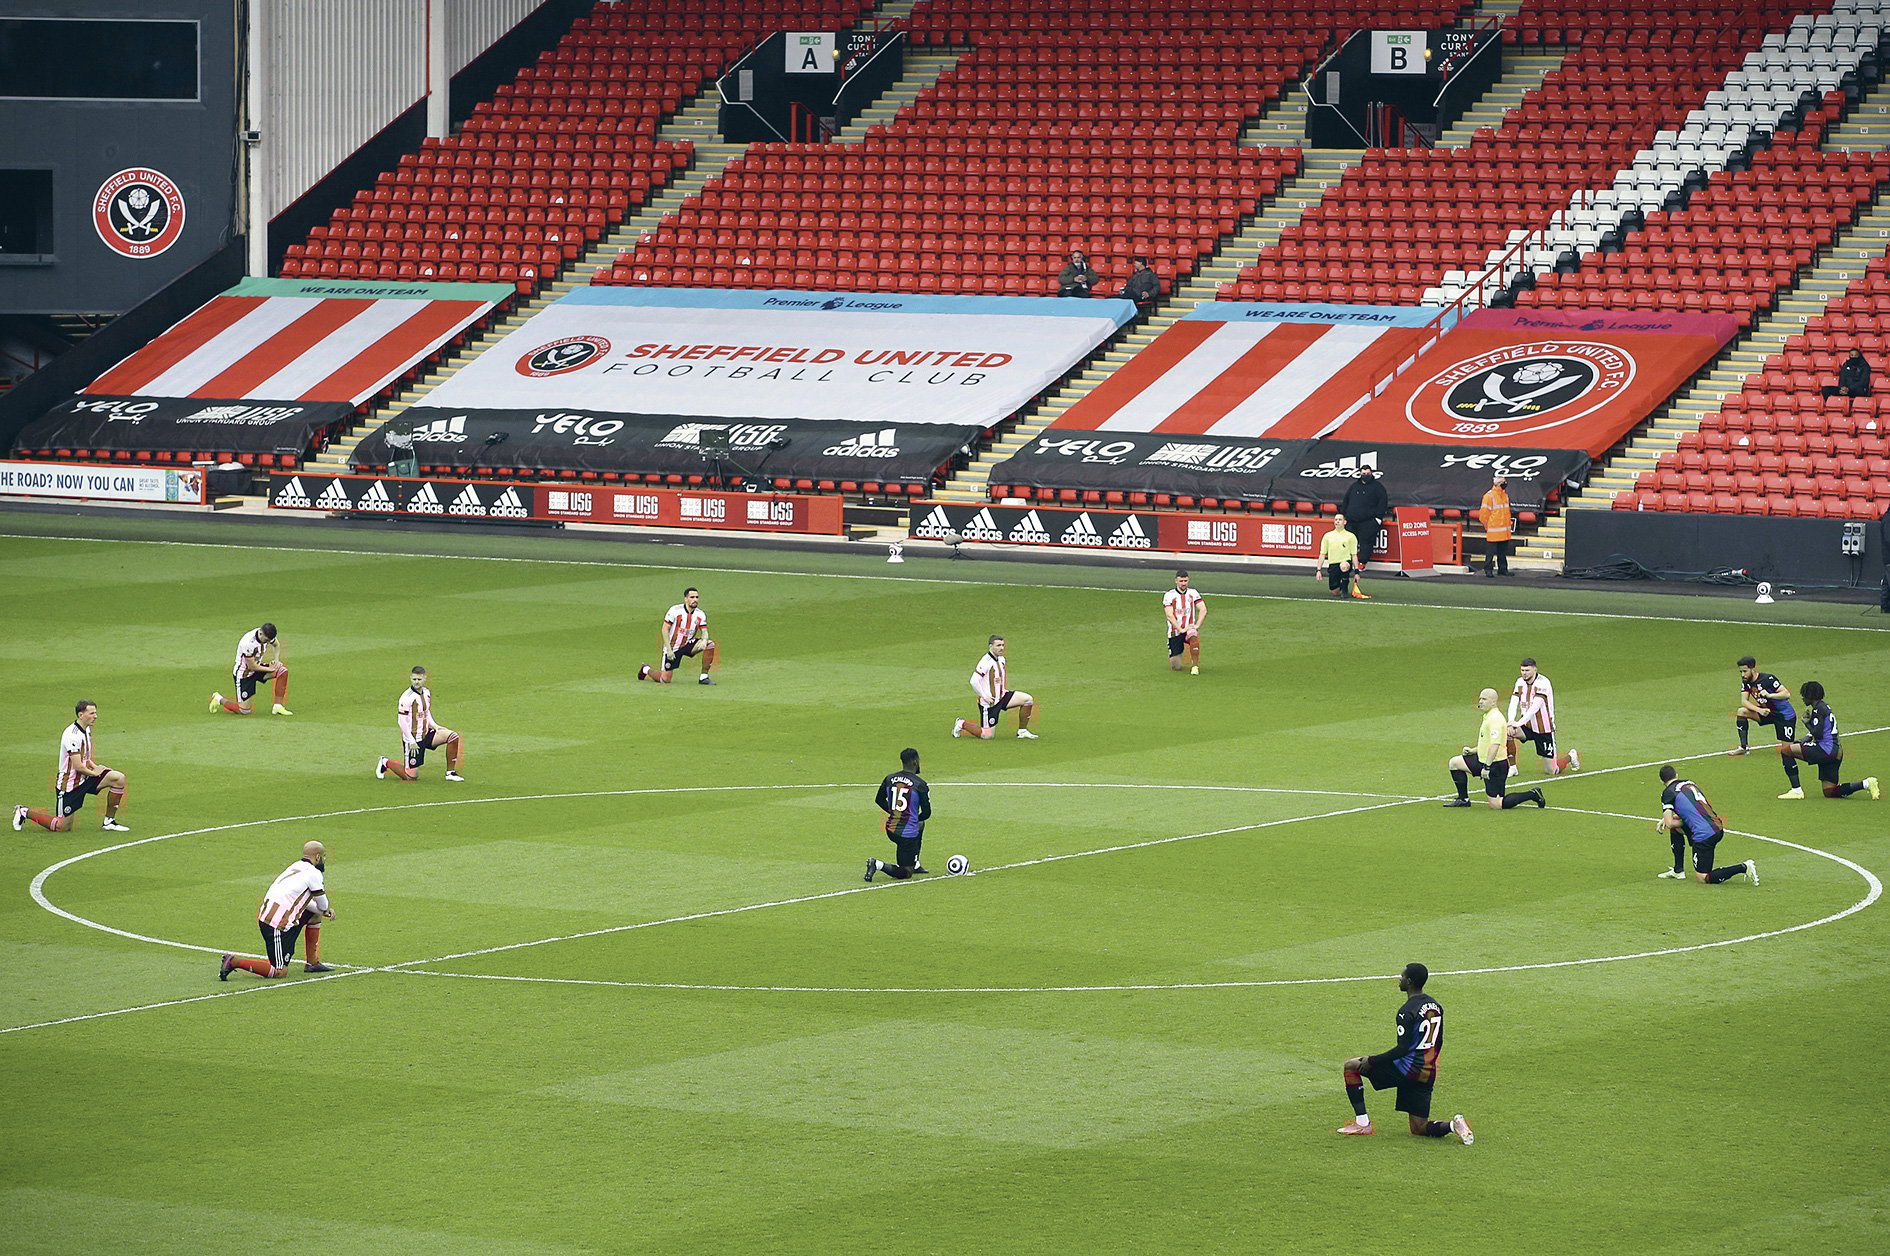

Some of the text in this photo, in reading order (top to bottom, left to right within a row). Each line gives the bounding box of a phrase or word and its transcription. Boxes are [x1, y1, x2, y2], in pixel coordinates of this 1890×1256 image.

[801, 48, 818, 69] A
[1391, 47, 1407, 70] B
[97, 172, 180, 214] SHEFFIELD UNITED F.C.
[129, 245, 151, 254] 1889
[763, 297, 903, 311] Premier League
[1271, 311, 1308, 319] ARE
[1309, 312, 1346, 320] ONE
[1349, 313, 1397, 322] TEAM
[1608, 317, 1672, 331] League
[625, 343, 1013, 368] SHEFFIELD UNITED
[601, 362, 986, 386] FOOTBALL CLUB
[1435, 344, 1625, 392] SHEFFIELD UNITED F.C.
[70, 401, 159, 414] YELO
[234, 406, 304, 421] USG
[531, 413, 624, 437] YELO
[1451, 422, 1500, 434] 1889
[413, 430, 468, 443] didas
[822, 443, 900, 458] adidas
[1034, 438, 1136, 456] YELO
[1206, 446, 1282, 469] USG
[1440, 453, 1547, 469] YELO
[17, 472, 53, 488] ROAD?
[56, 473, 83, 489] NOW
[88, 475, 110, 491] YOU
[113, 477, 134, 492] CAN
[274, 496, 311, 508] adidas
[315, 496, 352, 510] adidas
[357, 499, 395, 512] adidas
[407, 501, 444, 514] adidas
[570, 492, 592, 511] USG
[636, 495, 658, 514] USG
[703, 498, 725, 518] USG
[448, 503, 486, 516] adidas
[489, 505, 528, 518] adidas
[915, 525, 956, 538] adidas
[1212, 521, 1237, 541] USG
[1414, 521, 1427, 529] ZONE
[961, 527, 1003, 541] adidas
[1008, 529, 1051, 544] adidas
[1060, 532, 1102, 546] adidas
[1108, 534, 1150, 548] adidas
[1287, 524, 1312, 545] USG
[1783, 726, 1793, 739] 10
[1543, 742, 1553, 753] 14
[890, 786, 910, 812] 15
[1692, 852, 1699, 865] 4
[1415, 1015, 1441, 1050] 27
